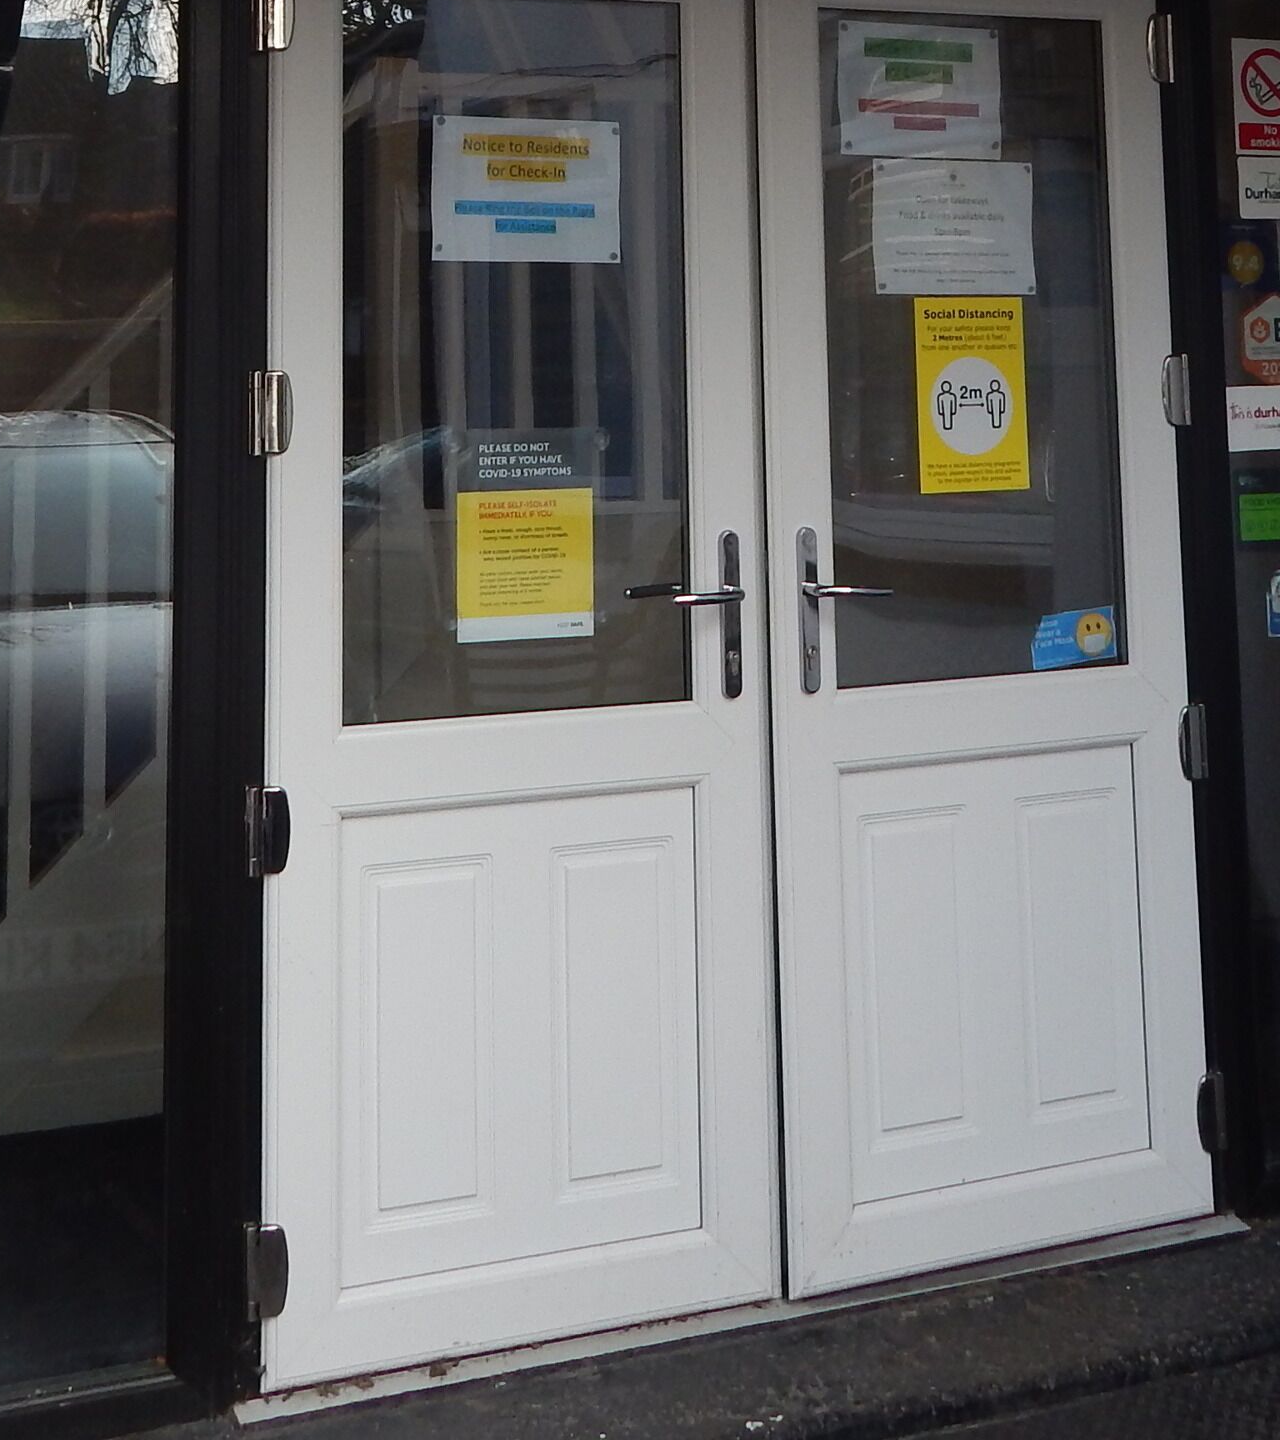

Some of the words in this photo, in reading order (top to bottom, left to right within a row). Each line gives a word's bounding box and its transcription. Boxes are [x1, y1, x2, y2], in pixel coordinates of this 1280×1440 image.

[1263, 124, 1278, 135] No
[462, 138, 505, 153] Notice
[509, 140, 523, 153] to
[526, 140, 590, 156] Residents
[486, 162, 505, 177] for
[509, 164, 566, 179] Check-In
[923, 309, 956, 320] Social
[958, 308, 1014, 321] Distancing
[959, 385, 983, 400] 2m
[479, 443, 512, 453] PLEASE
[514, 443, 528, 452] DO
[529, 442, 550, 452] NOT
[479, 456, 508, 466] ENTER
[509, 456, 518, 465] IF
[519, 455, 538, 464] YOU
[539, 454, 563, 464] HAVE
[478, 468, 522, 478] COVID-19
[523, 466, 572, 477] SYMPTOMS
